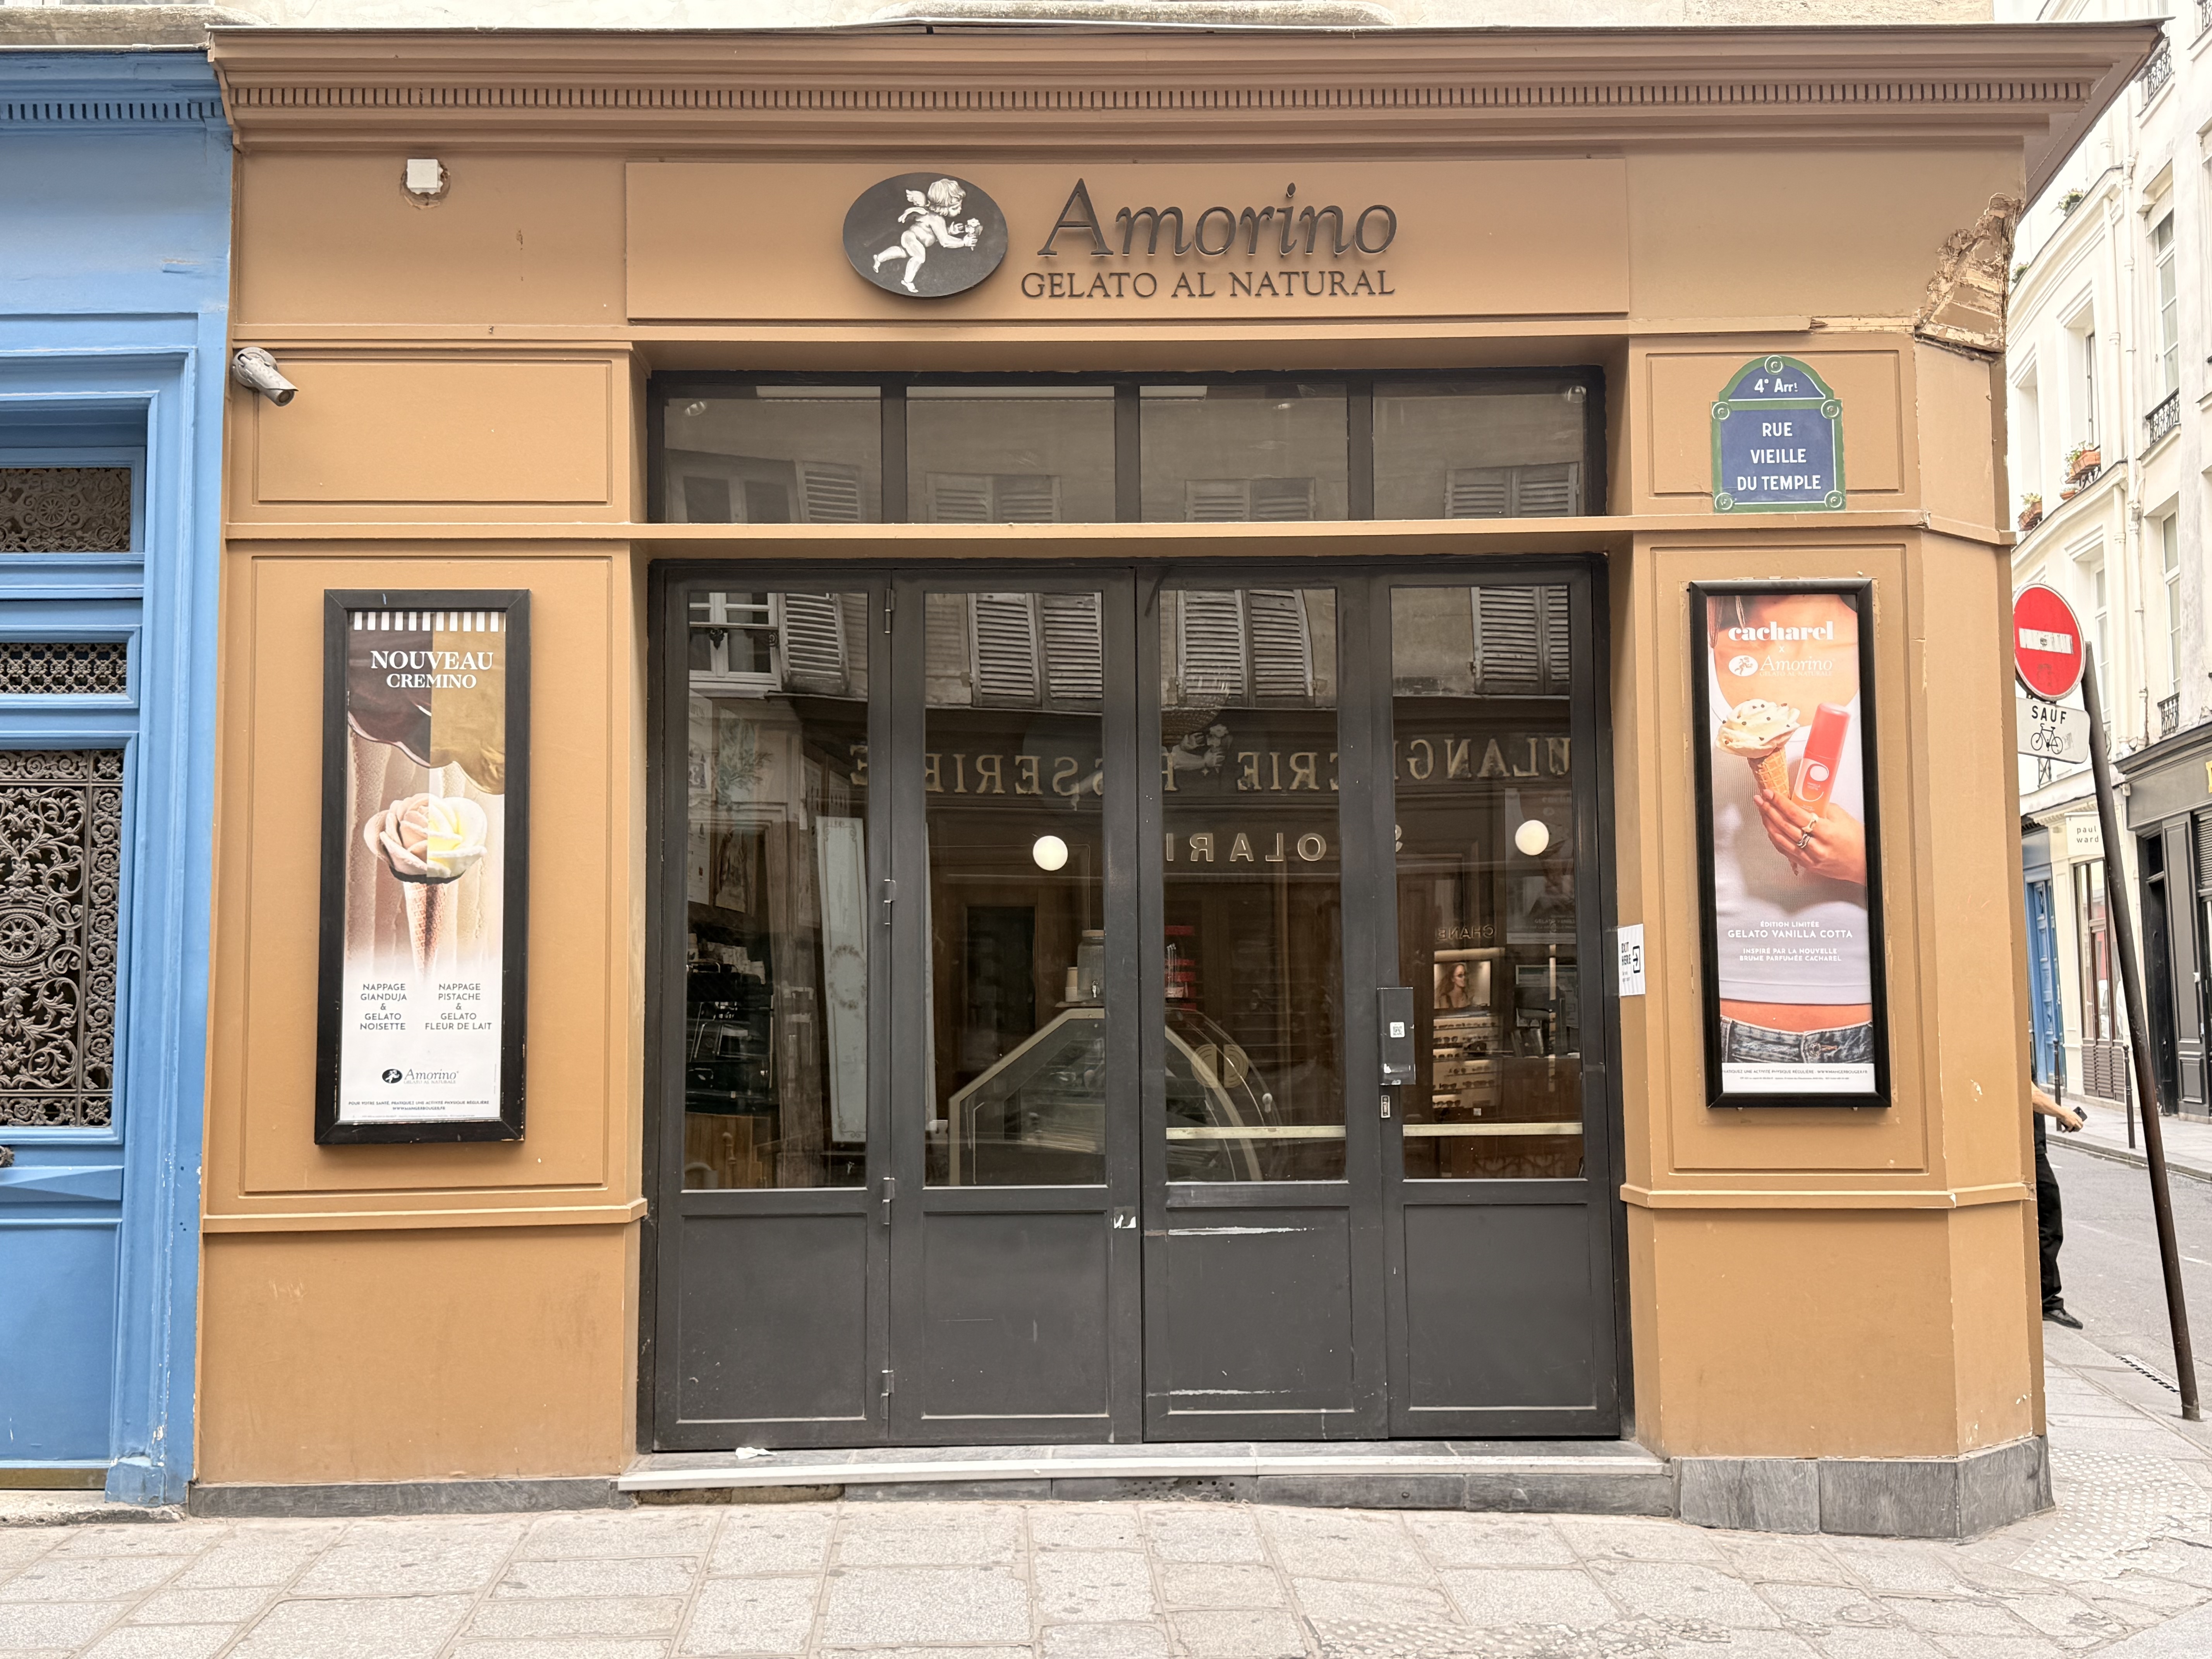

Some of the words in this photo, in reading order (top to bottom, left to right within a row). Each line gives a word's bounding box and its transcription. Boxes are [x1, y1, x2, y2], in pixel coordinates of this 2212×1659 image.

[1037, 178, 1397, 256] Amorino
[1021, 272, 1157, 298] GELATO
[1171, 272, 1216, 298] AL
[1229, 270, 1396, 297] NATURAL
[1762, 422, 1793, 437] RUE
[1750, 448, 1807, 464] VIEILLE
[1737, 476, 1757, 490] DU
[1761, 475, 1821, 490] TEMPLE
[1728, 621, 1834, 641] cacharel
[370, 651, 494, 670] NOUVEAU
[1760, 655, 1832, 671] Amorino
[386, 673, 477, 689] CREMINO
[2032, 705, 2066, 724] SAUF
[2077, 825, 2096, 835] paul
[1728, 930, 1768, 938] GELATO
[1772, 930, 1816, 938] VANILLA
[1820, 930, 1853, 938] COTTA
[1622, 954, 1631, 966] HERE
[360, 993, 407, 1001] GIANDUJA
[404, 1068, 456, 1080] Amorino
